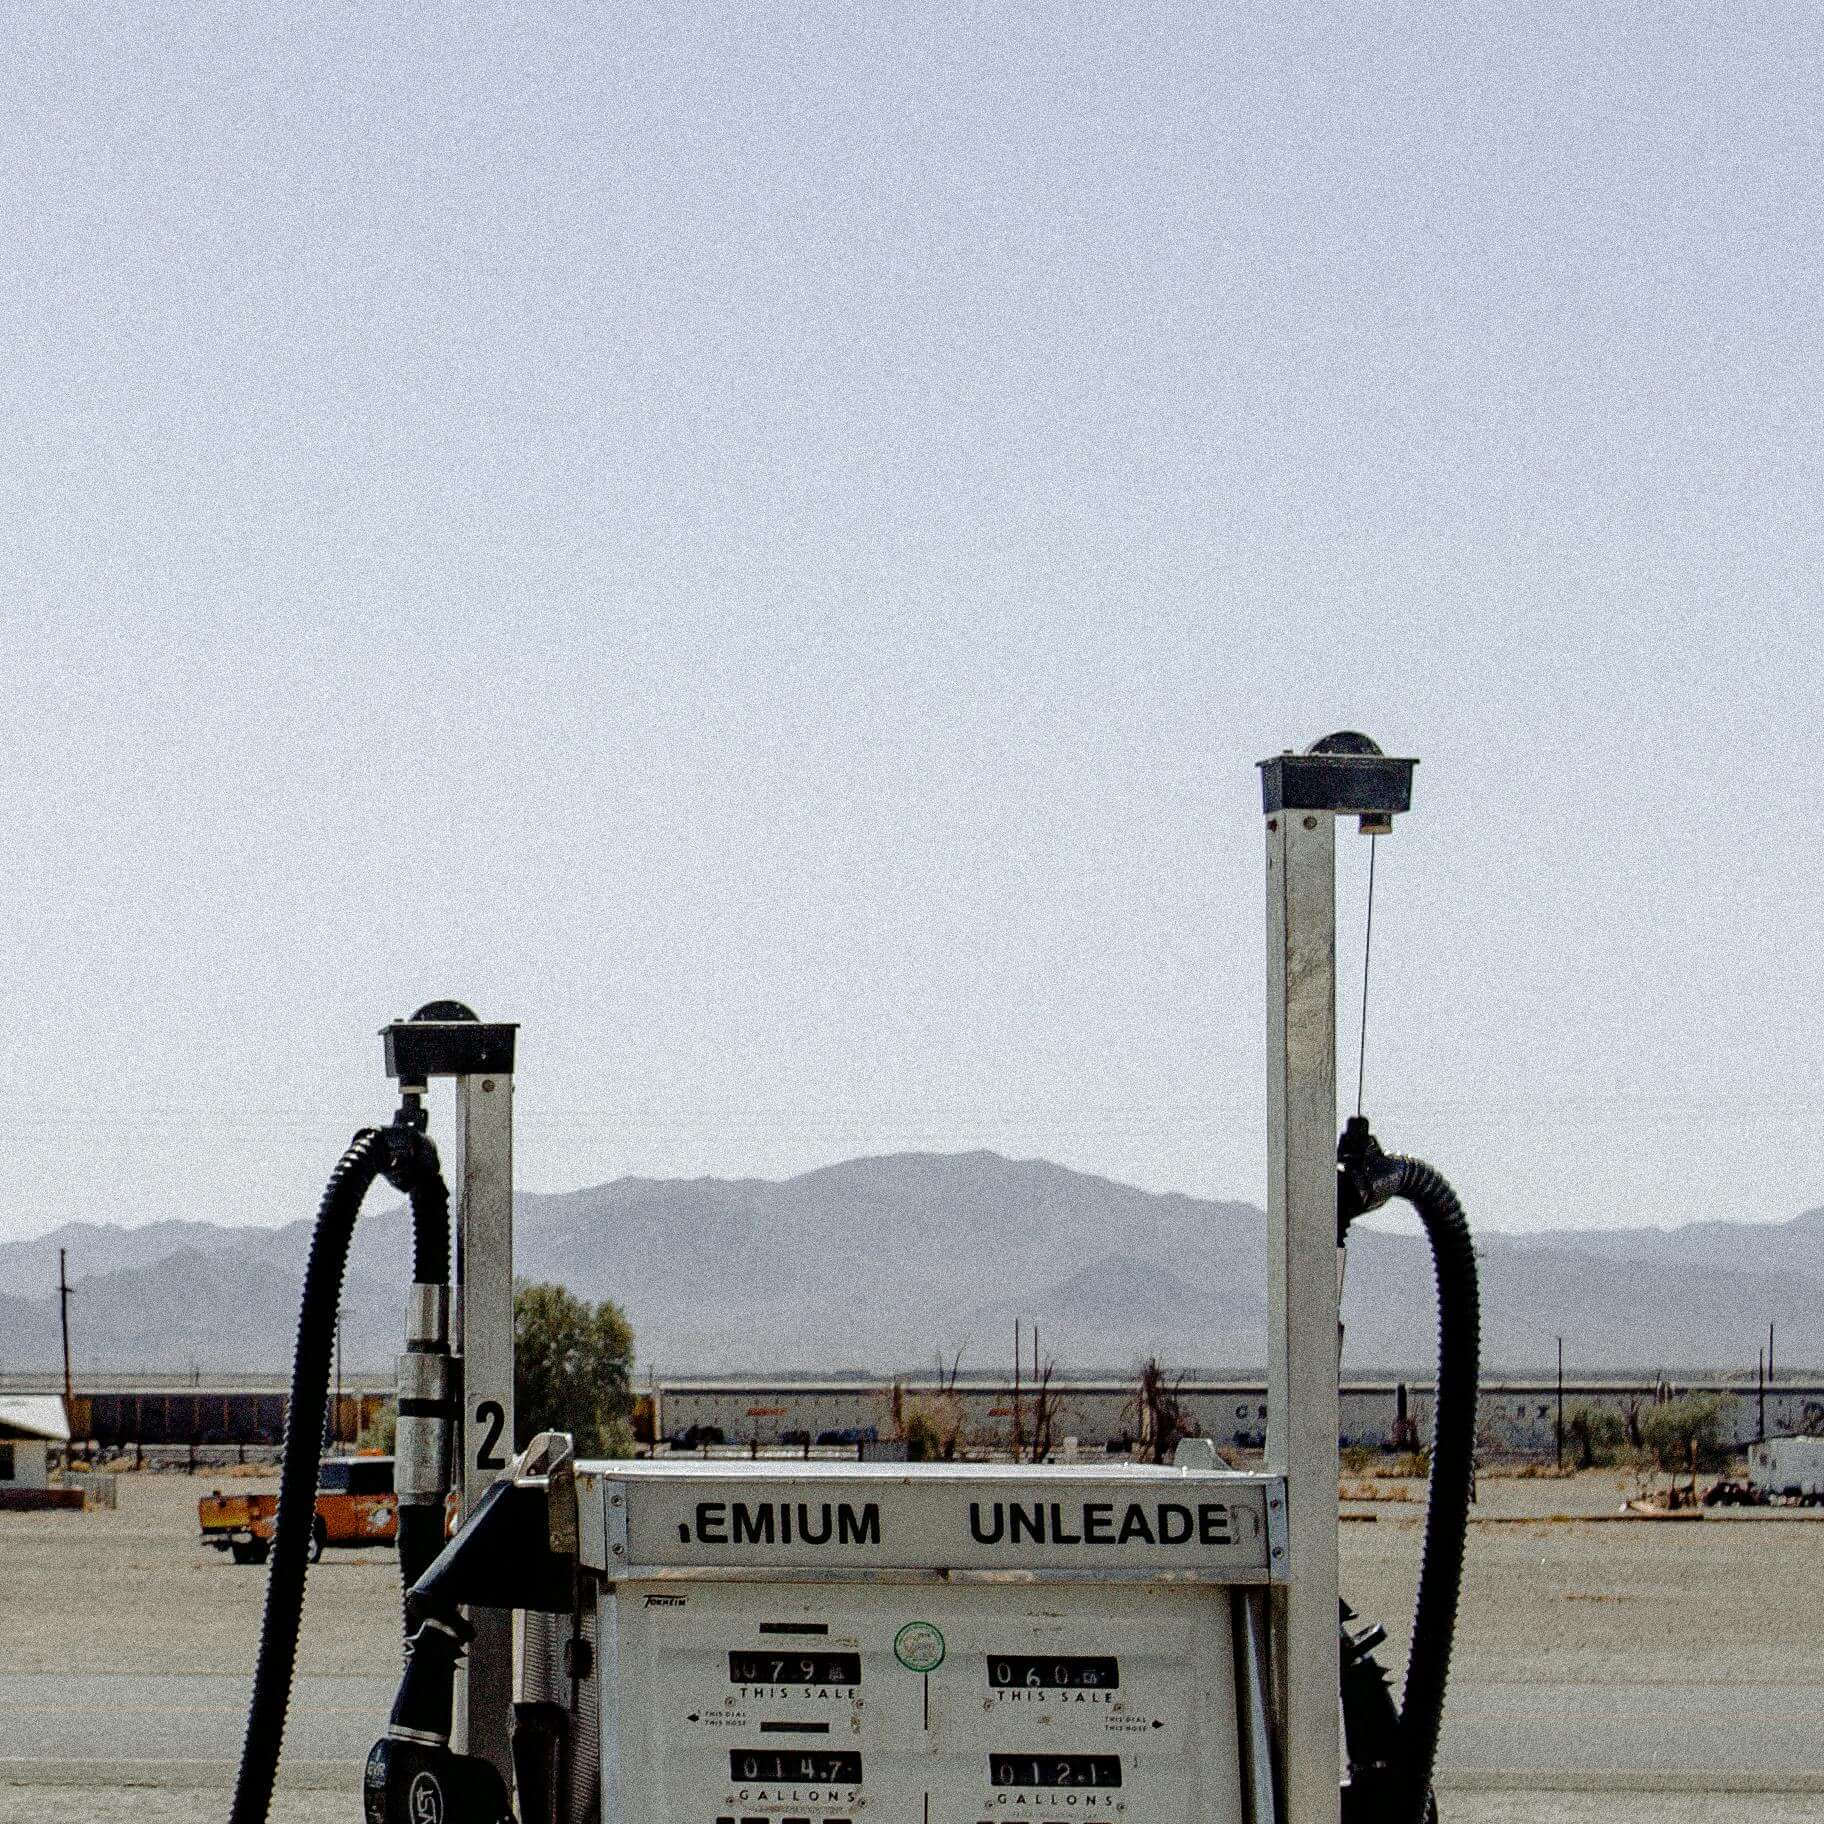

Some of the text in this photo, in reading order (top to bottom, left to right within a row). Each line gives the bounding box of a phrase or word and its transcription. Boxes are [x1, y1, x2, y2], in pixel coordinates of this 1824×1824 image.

[475, 1399, 506, 1470] 2
[677, 1502, 881, 1545] EMIUM
[739, 1688, 856, 1700] THIS SALE
[997, 1691, 1113, 1704] THIS SALE
[739, 1789, 856, 1803] GALLONS
[997, 1794, 1113, 1806] GALLONS
